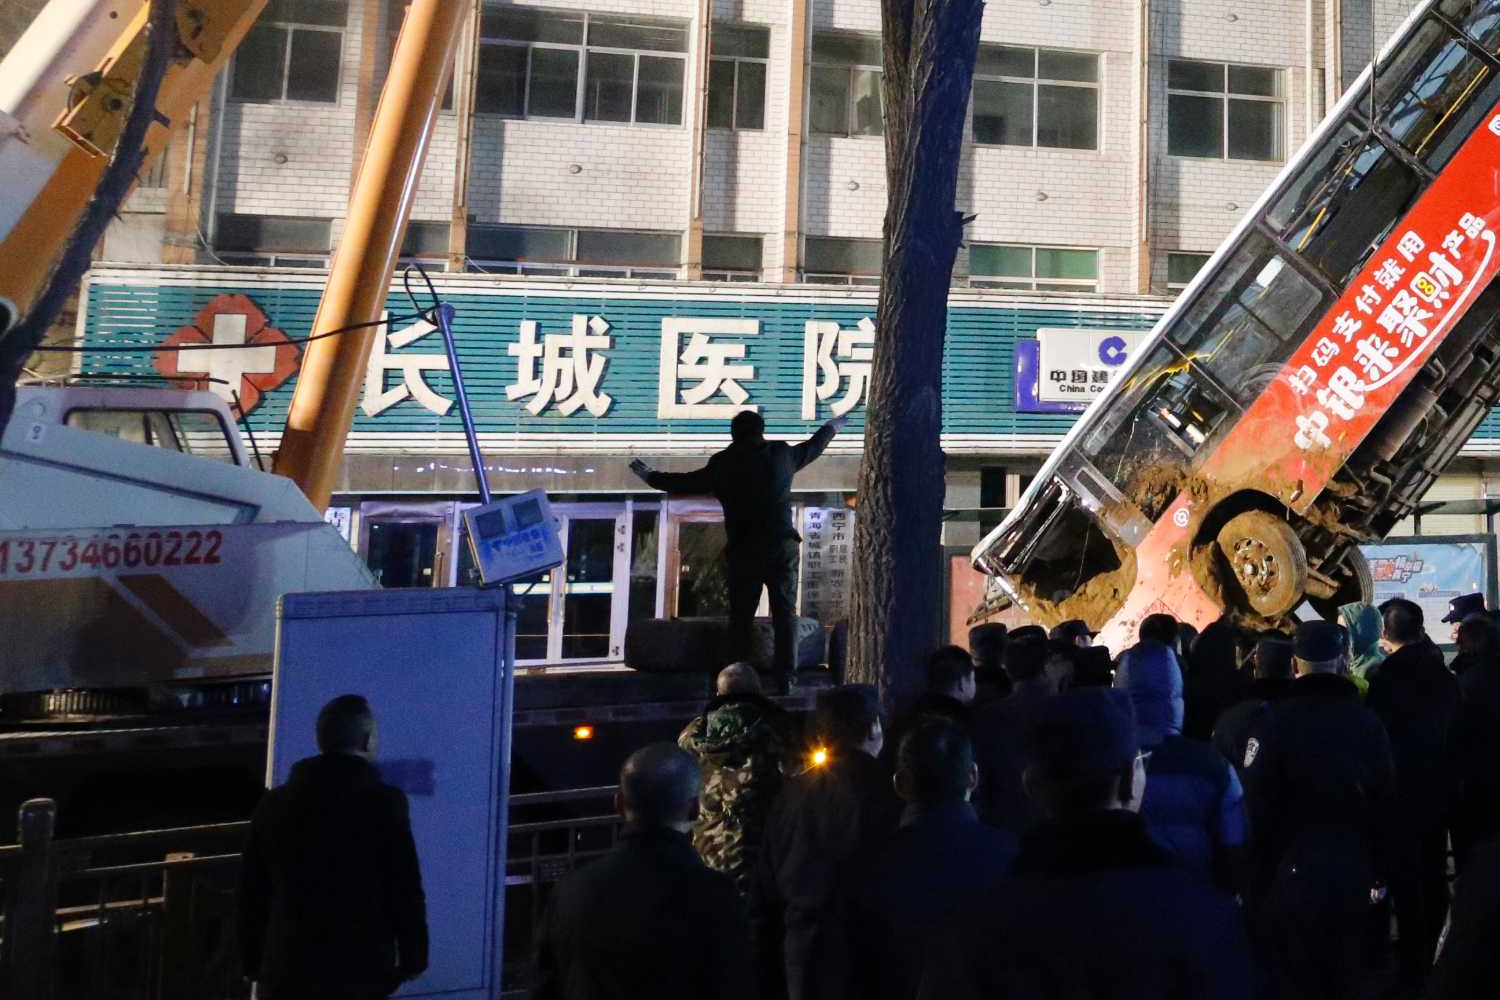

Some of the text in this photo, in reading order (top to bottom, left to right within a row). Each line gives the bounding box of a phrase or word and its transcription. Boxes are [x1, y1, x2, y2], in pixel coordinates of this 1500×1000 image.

[1288, 231, 1425, 396] 扫码支付就用
[362, 311, 878, 421] 长城医院
[1059, 384, 1086, 393] China
[0, 530, 224, 574] 13734660222
